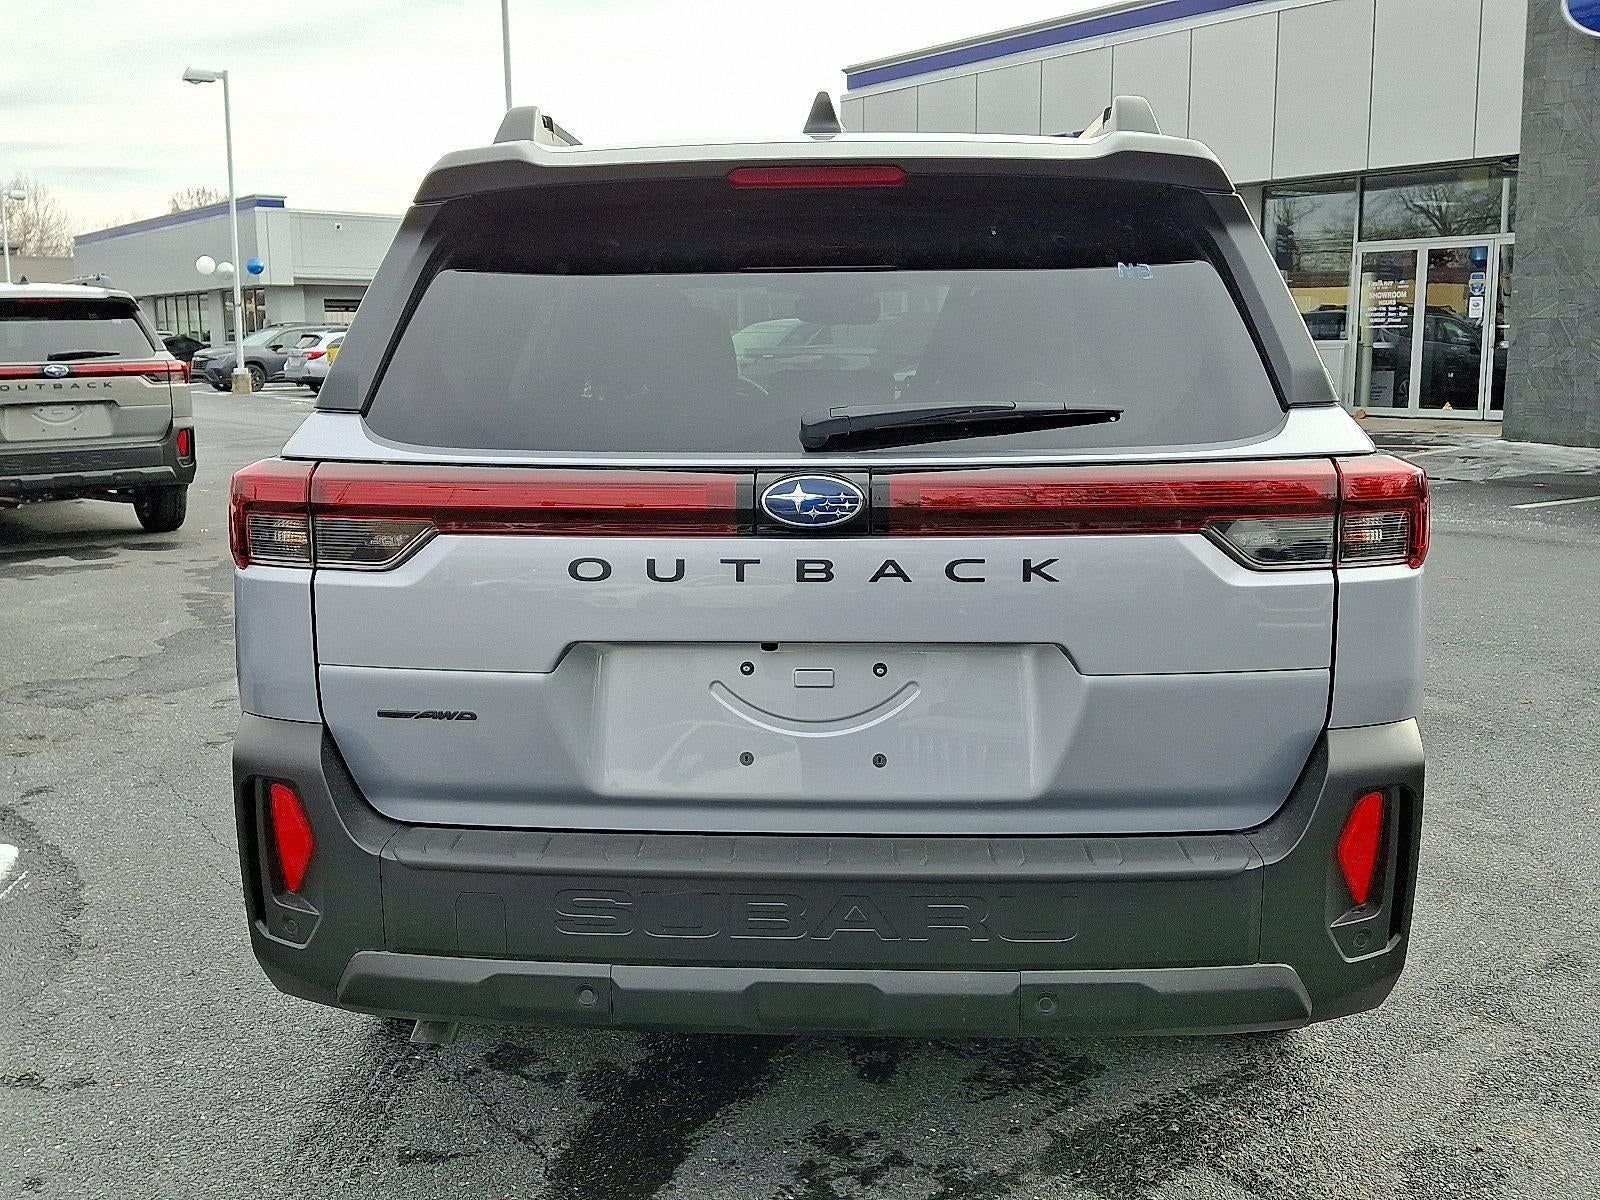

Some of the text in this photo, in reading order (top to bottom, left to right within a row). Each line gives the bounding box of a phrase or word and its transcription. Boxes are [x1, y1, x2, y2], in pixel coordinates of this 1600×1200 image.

[1368, 290, 1408, 299] SHOWROOM
[0, 381, 113, 392] OUTBACK
[567, 557, 1060, 583] OUTBACK
[413, 710, 478, 720] AWD
[554, 889, 1079, 944] SUBARU
